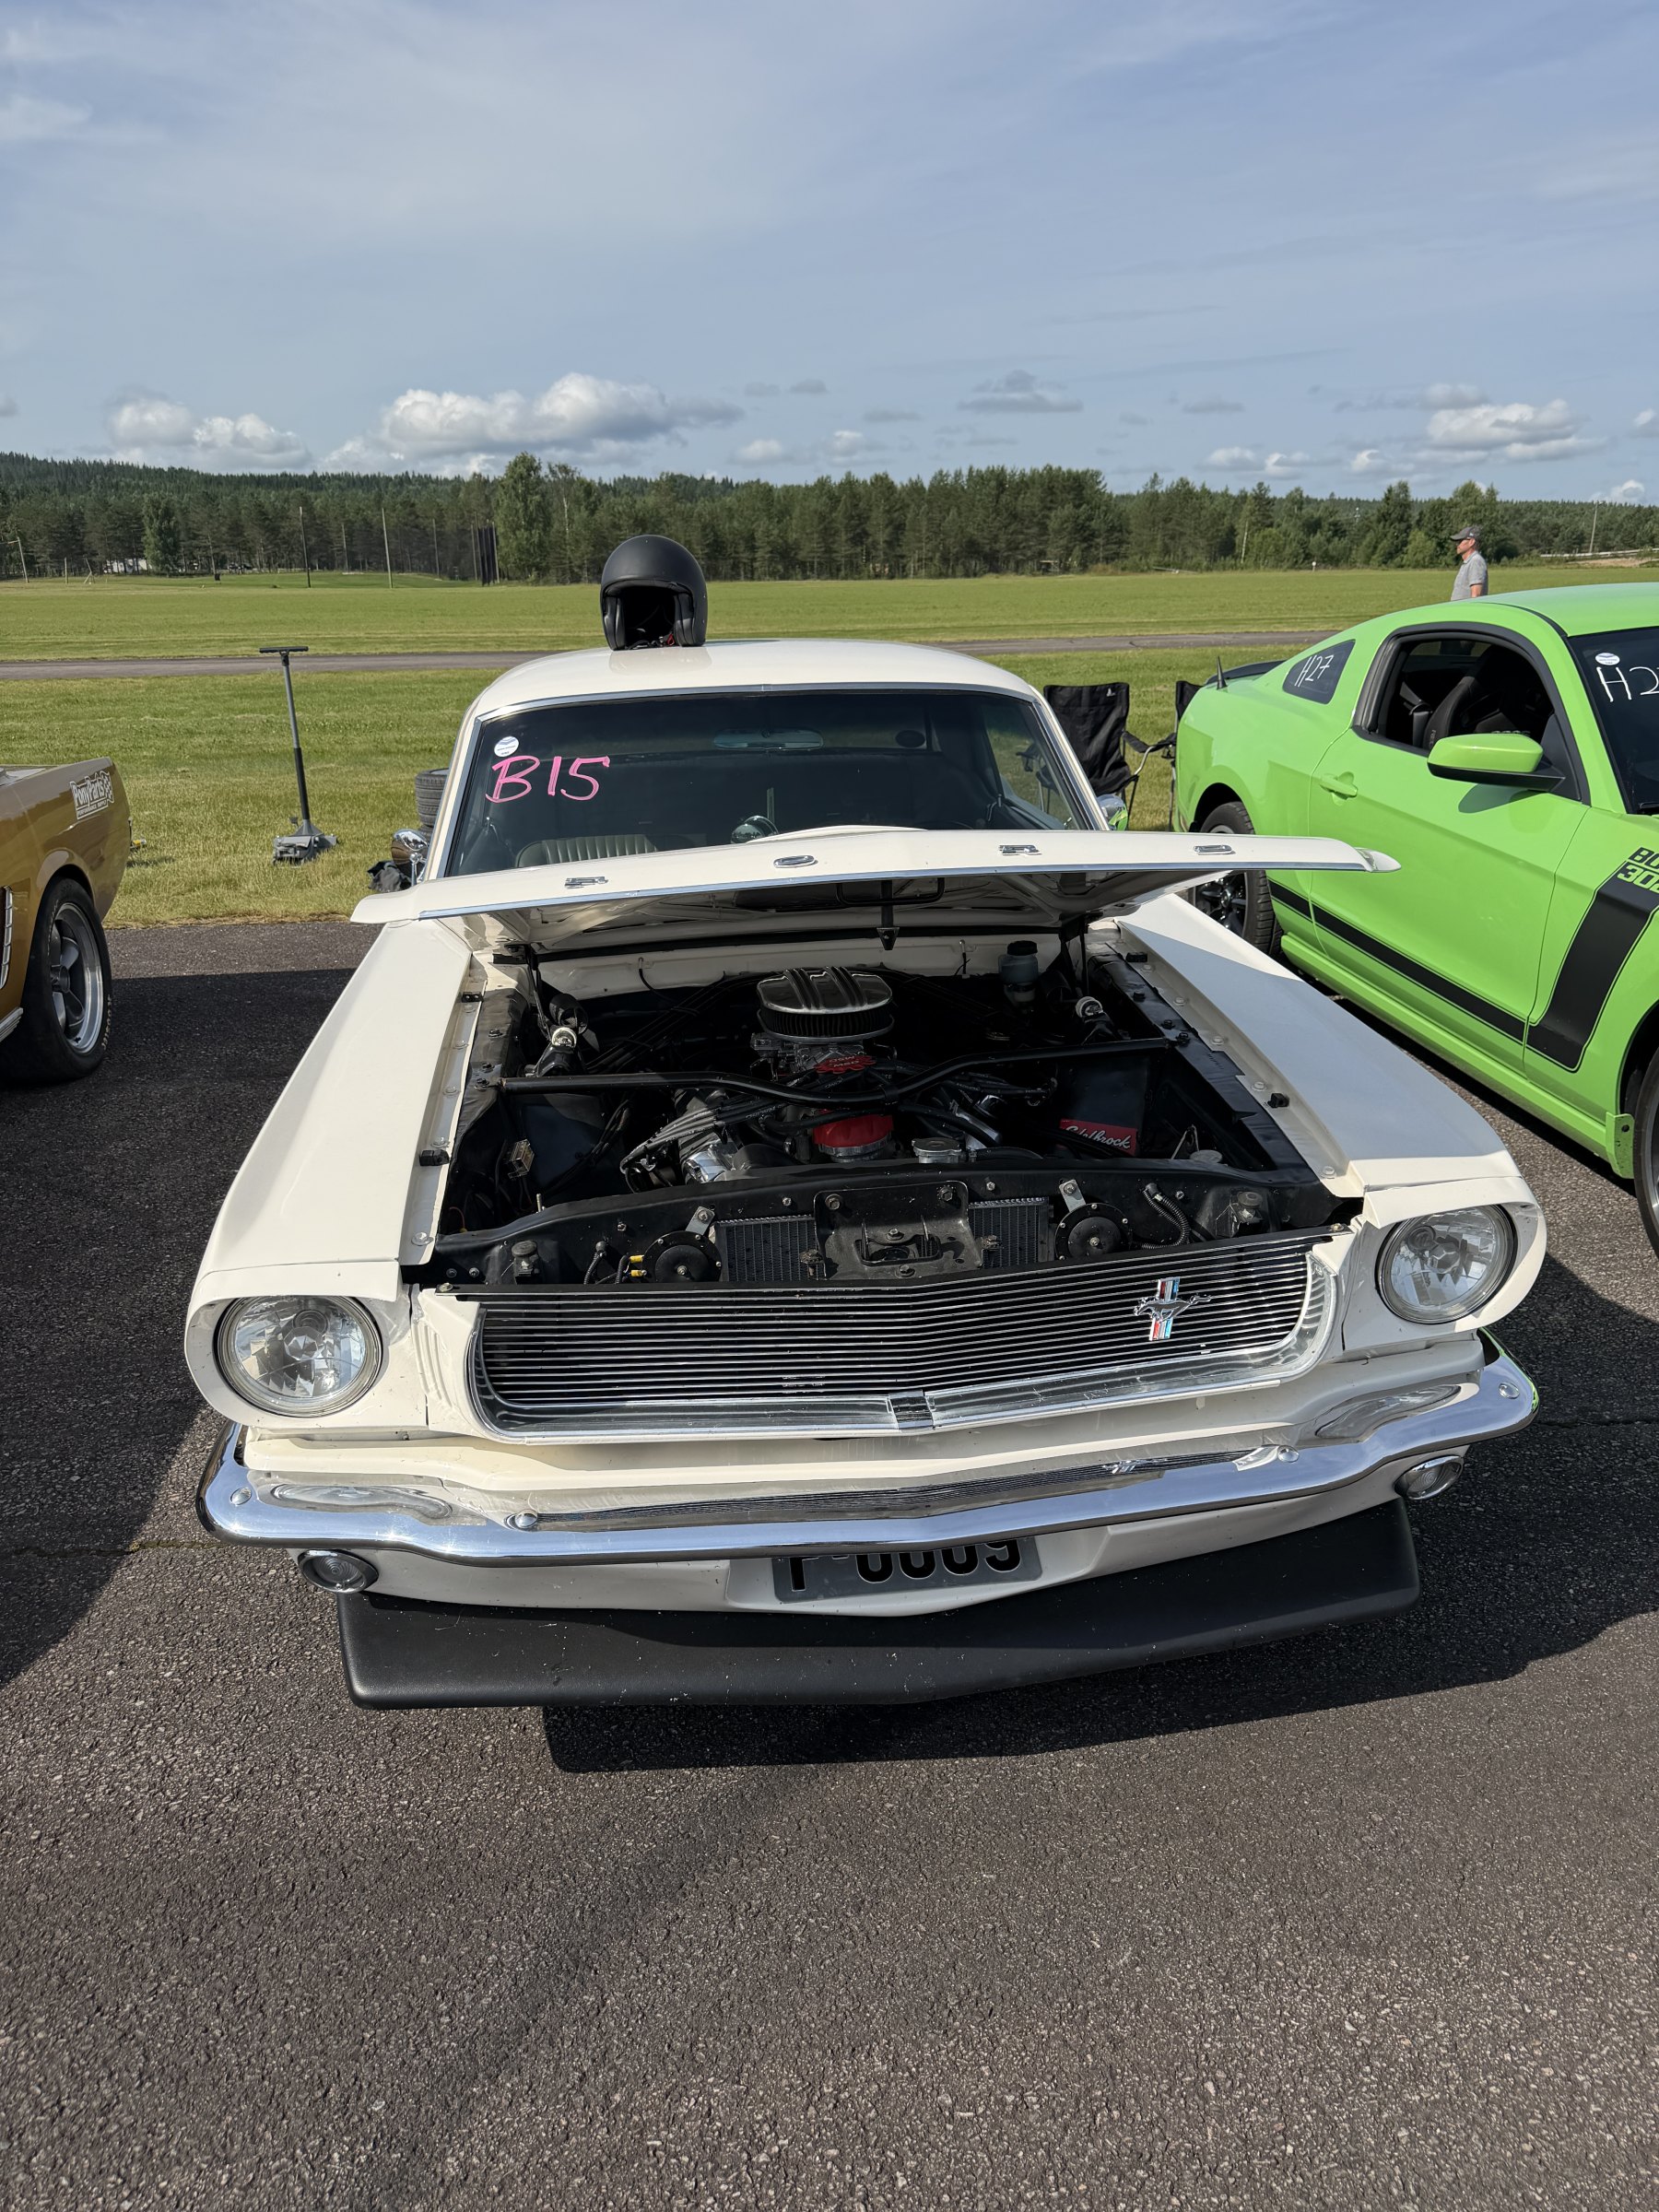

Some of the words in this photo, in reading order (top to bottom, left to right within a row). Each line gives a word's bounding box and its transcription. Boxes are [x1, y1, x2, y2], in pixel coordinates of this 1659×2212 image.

[1294, 654, 1335, 688] H27
[1596, 666, 1659, 702] H2
[485, 755, 611, 804] B15
[1617, 864, 1659, 895] 30
[1065, 1125, 1132, 1150] lbrock
